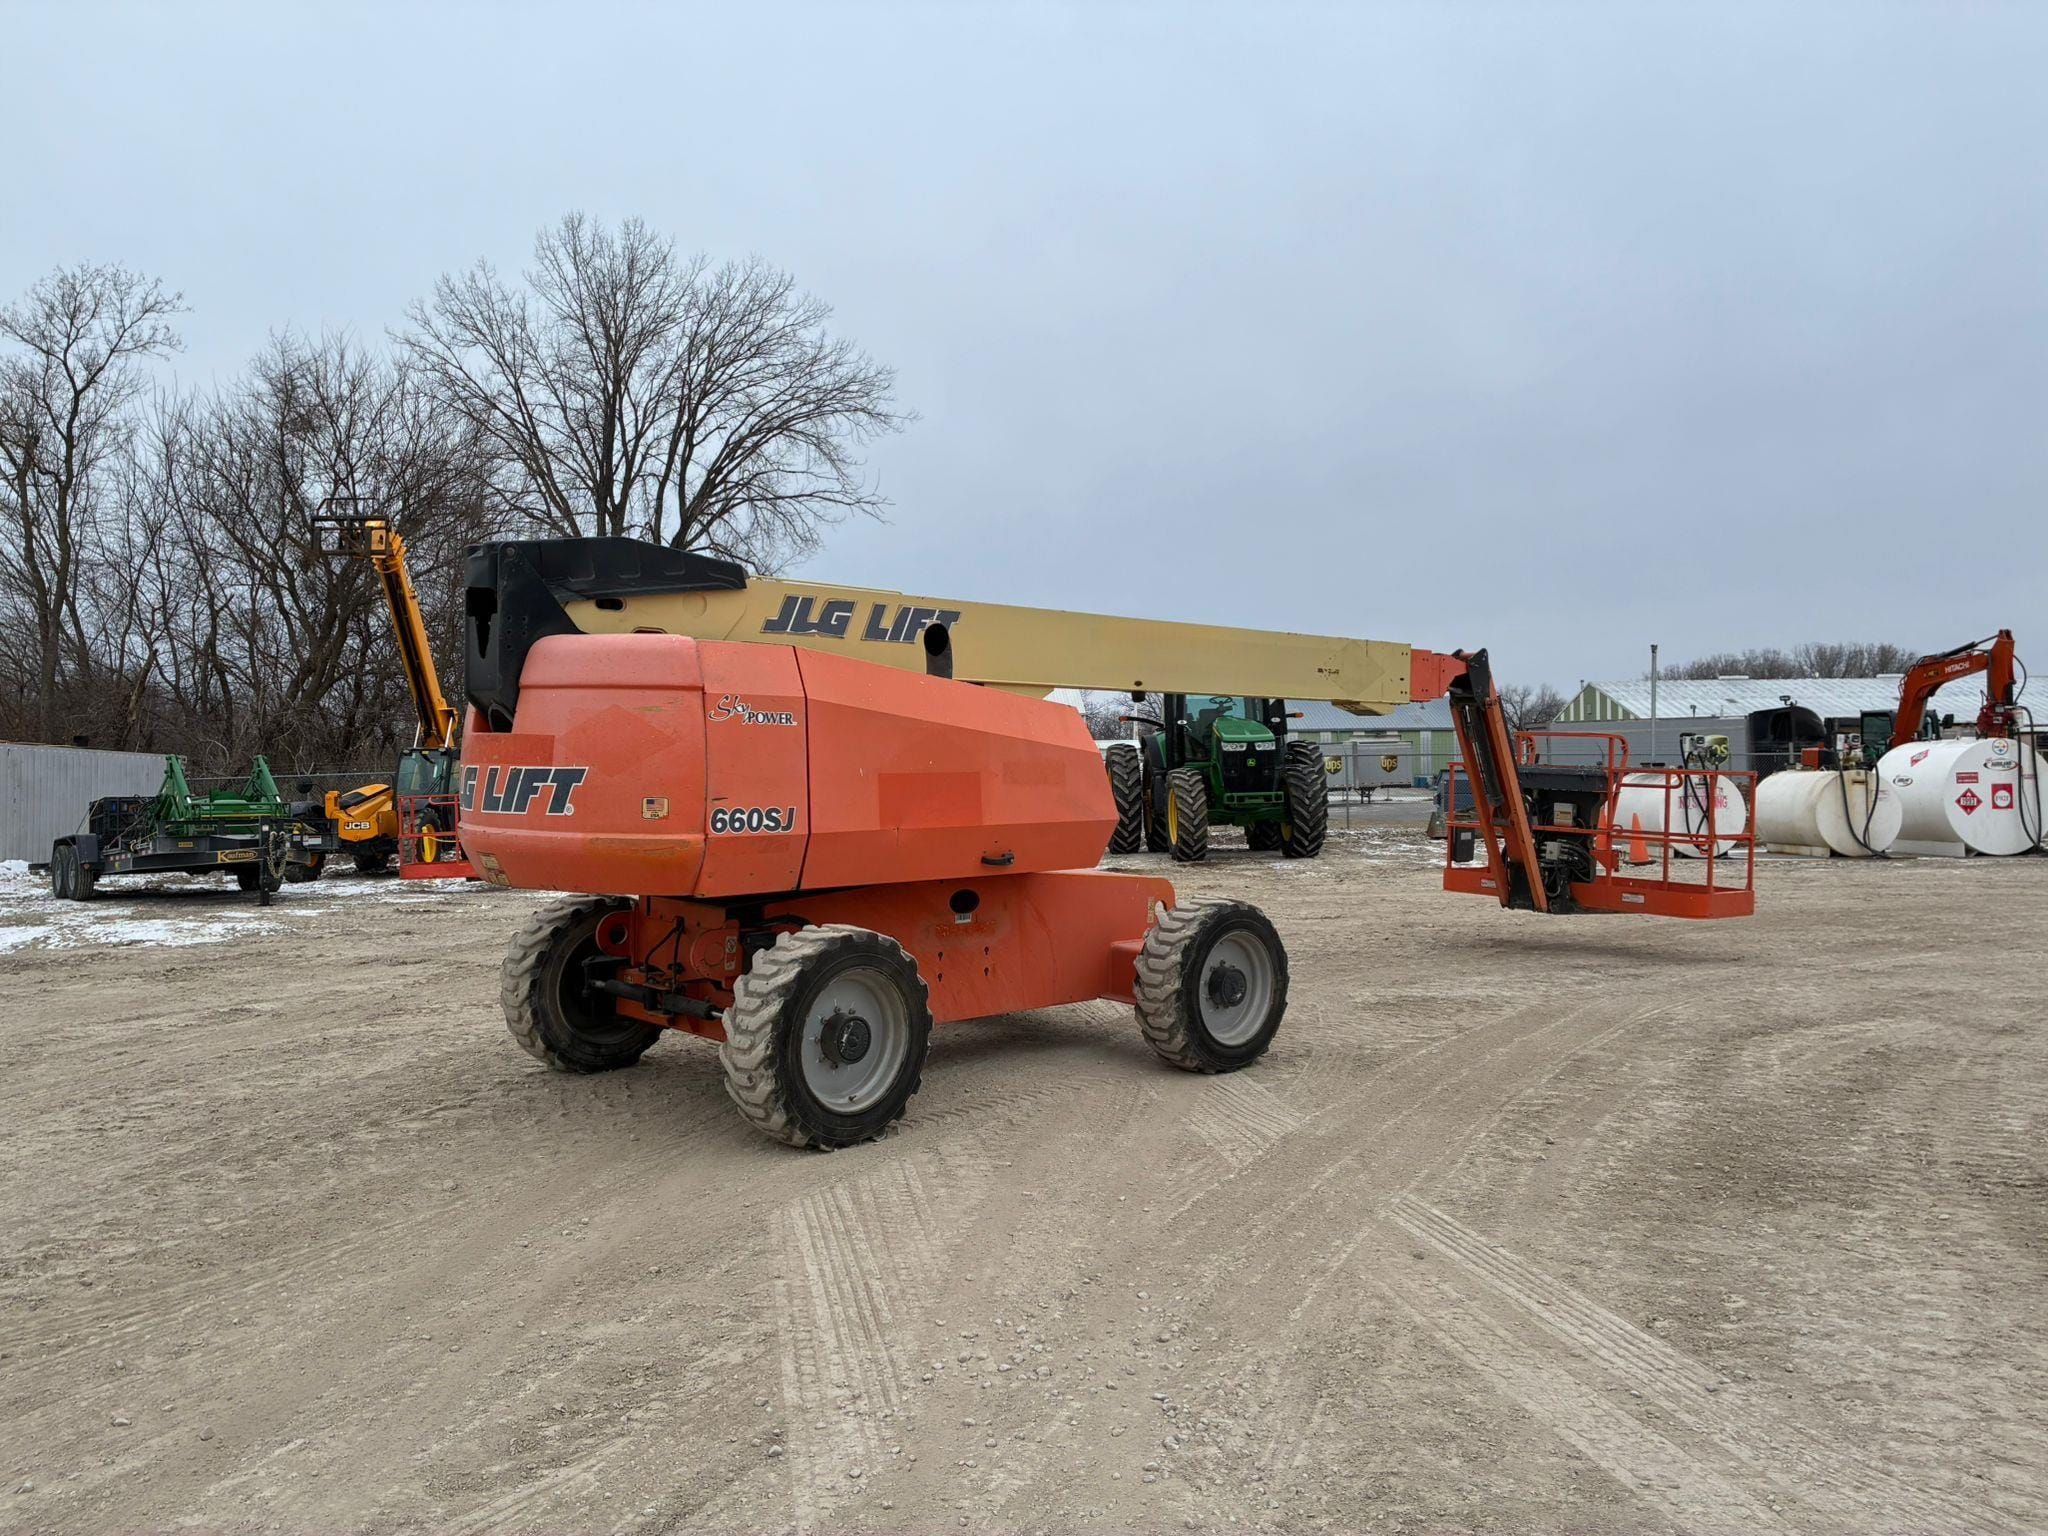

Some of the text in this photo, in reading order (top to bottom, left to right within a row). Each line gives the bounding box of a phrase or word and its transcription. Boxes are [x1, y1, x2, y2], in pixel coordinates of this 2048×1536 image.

[760, 594, 856, 639] JLG
[1944, 661, 1970, 674] HITACHI
[708, 694, 795, 725] Sky POWER
[481, 765, 589, 815] LIFT
[344, 821, 371, 830] JCB
[711, 807, 796, 835] 660SJ
[216, 851, 256, 864] Kaufman
